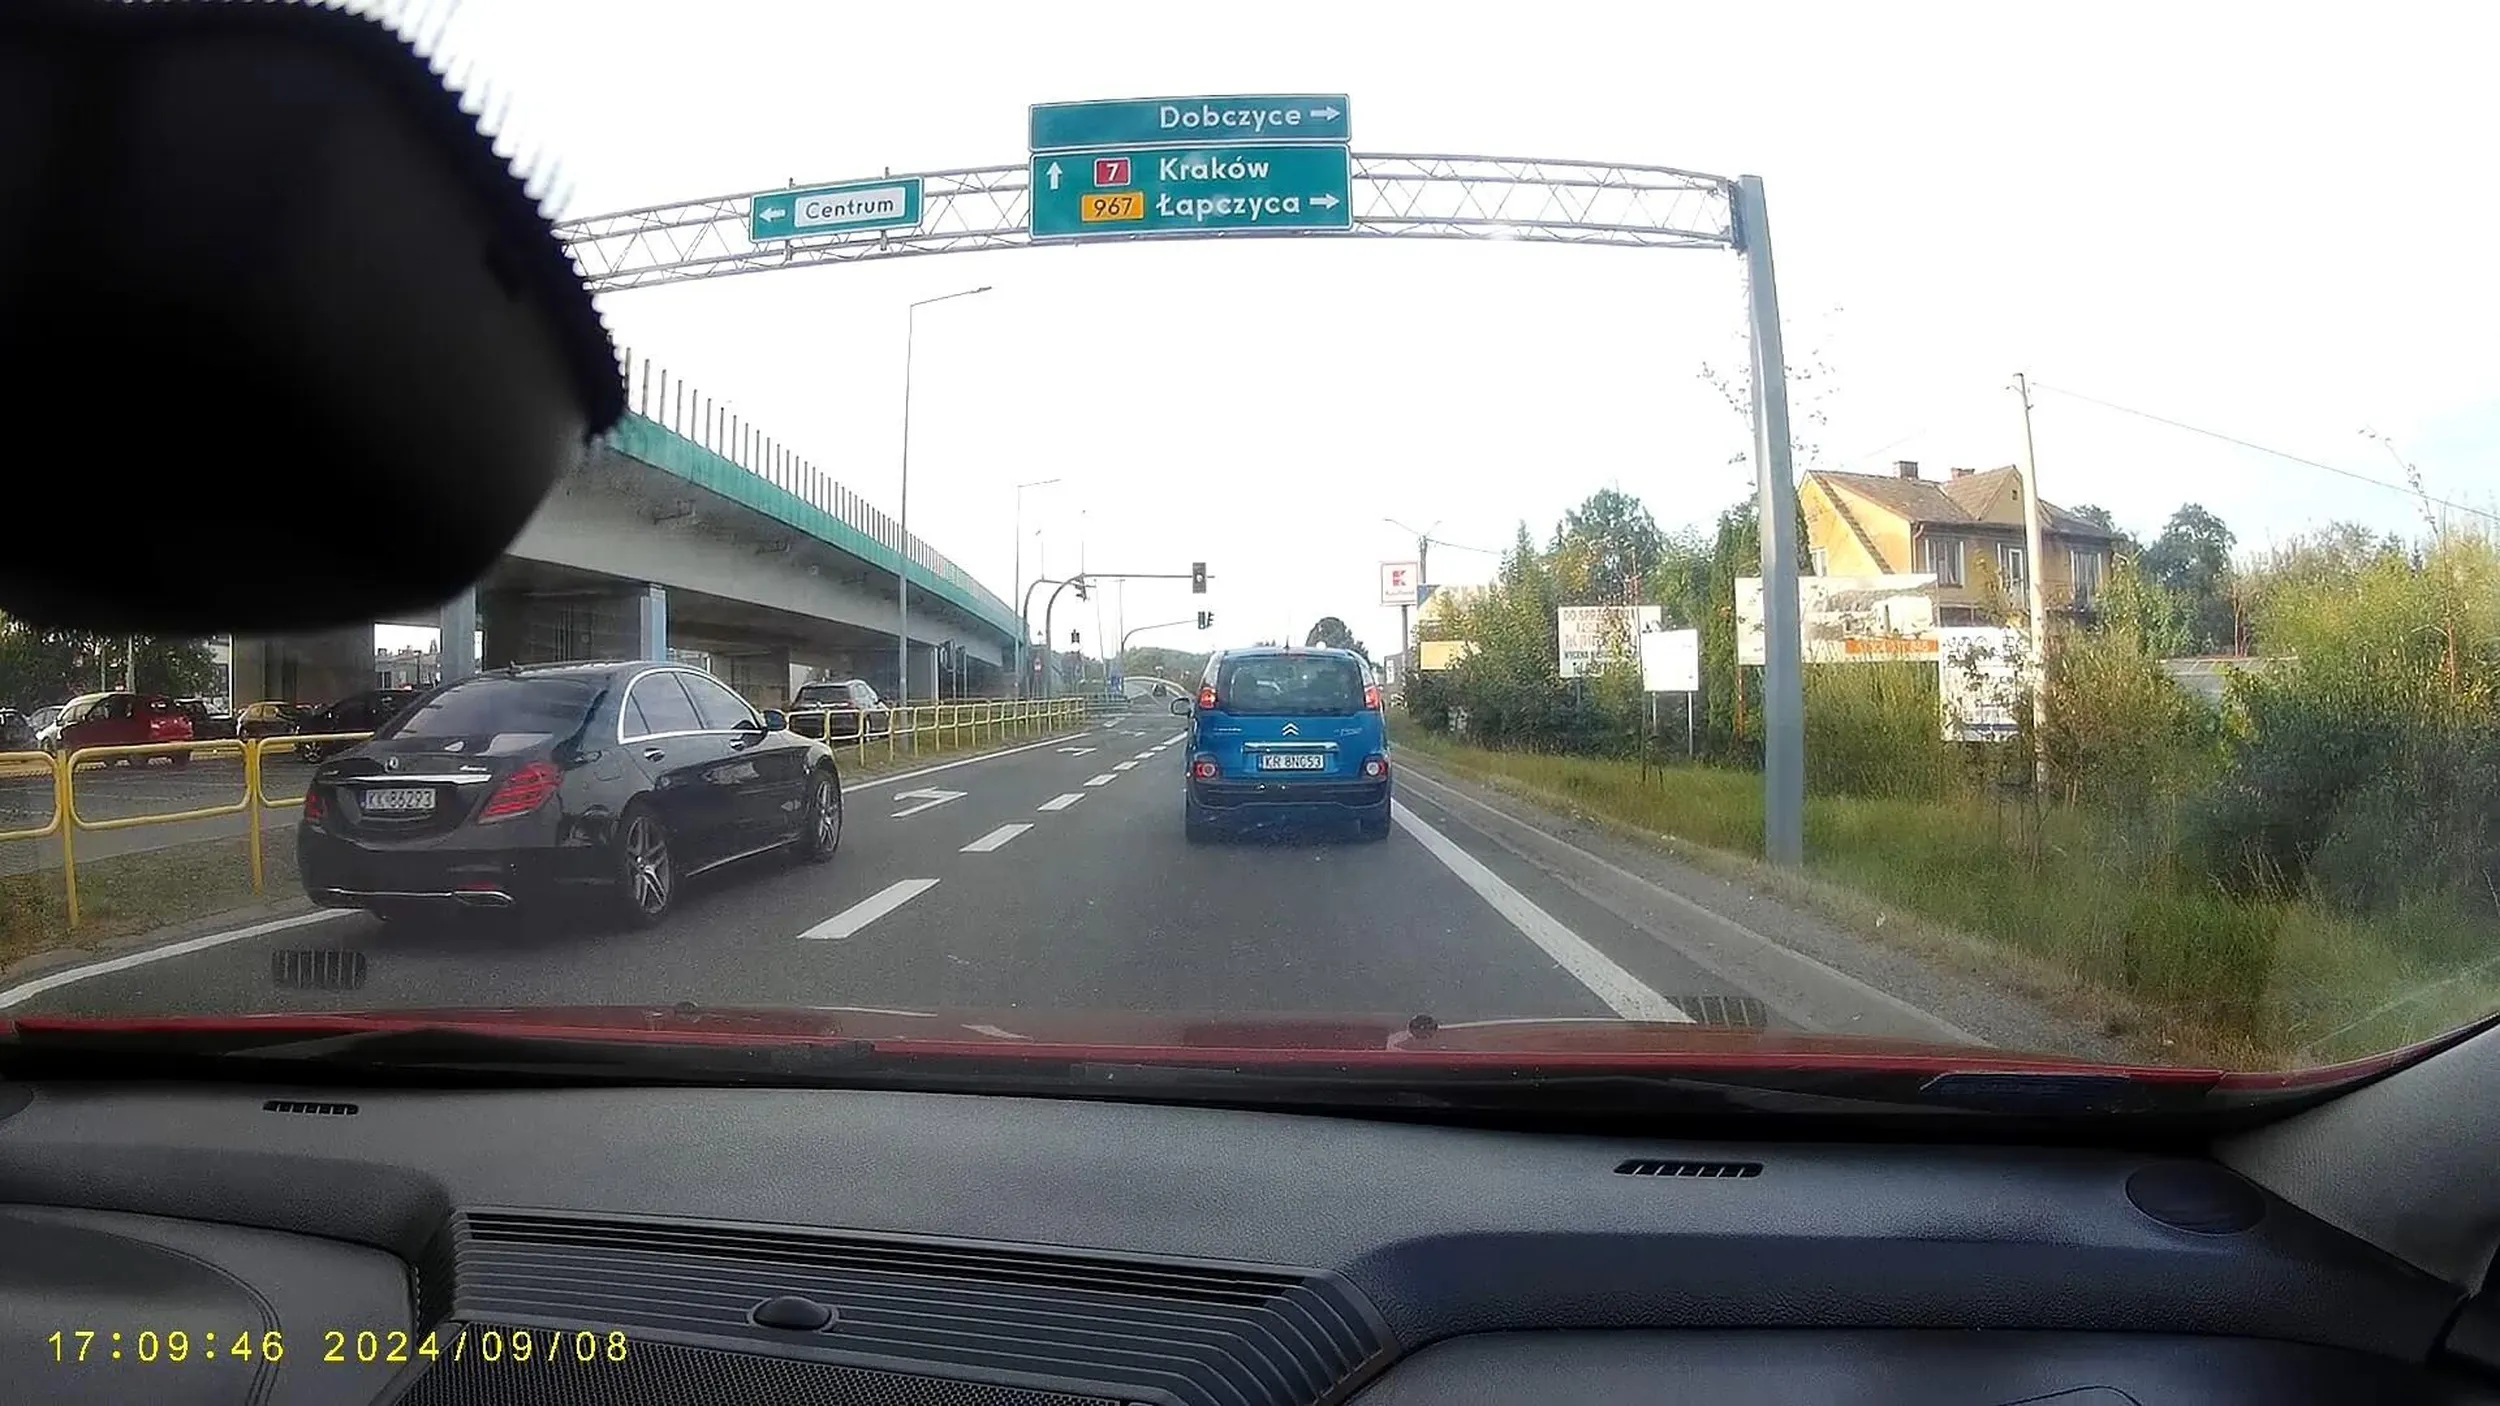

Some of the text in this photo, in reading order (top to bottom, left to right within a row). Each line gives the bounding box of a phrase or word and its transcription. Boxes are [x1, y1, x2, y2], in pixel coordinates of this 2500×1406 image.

[1159, 105, 1301, 132] Dobczyce
[1106, 156, 1269, 182] 7 Kraków
[805, 199, 894, 220] Centrum
[1093, 192, 1301, 221] 967 Łapczyca
[1265, 755, 1281, 767] KR
